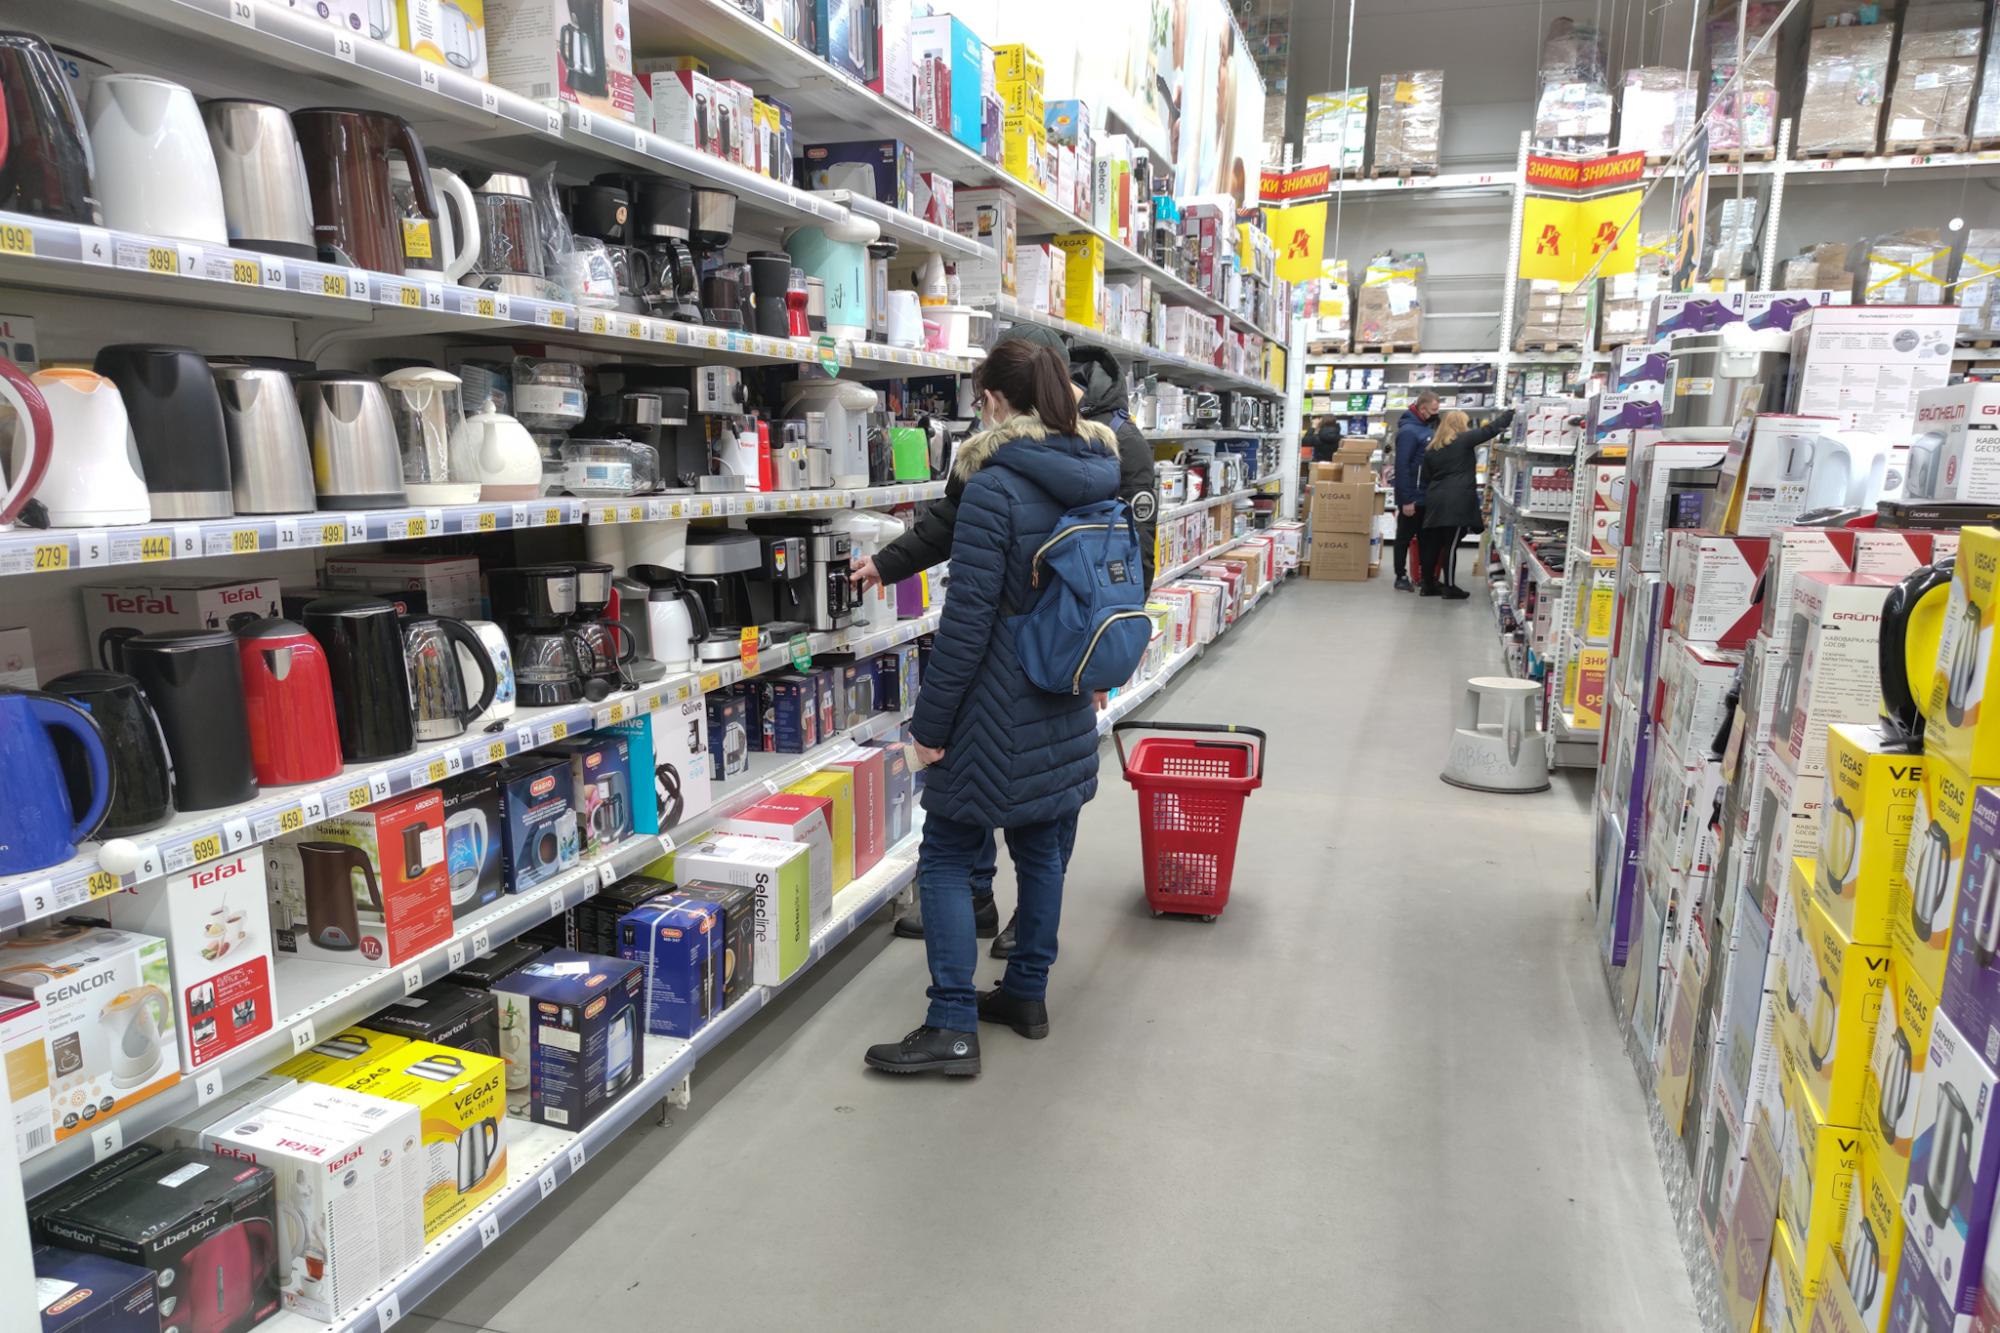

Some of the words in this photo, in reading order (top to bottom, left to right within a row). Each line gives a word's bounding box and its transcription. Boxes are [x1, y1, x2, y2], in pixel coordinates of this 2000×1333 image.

[236, 3, 250, 18] 10
[338, 40, 351, 54] 13
[424, 71, 434, 84] 16
[485, 94, 494, 106] 19
[549, 117, 559, 130] 22
[1528, 162, 1580, 181] ЗНИЖКИ
[1581, 157, 1642, 182] ЗНИЖКИ
[1281, 172, 1328, 193] ЗНИЖКИ
[92, 243, 102, 258] 4
[1056, 239, 1088, 247] VEGAS
[150, 248, 170, 270] 399
[188, 256, 196, 270] 7
[233, 264, 253, 282] 839
[267, 269, 282, 282] 10
[324, 276, 341, 294] 649
[354, 282, 366, 294] 13
[402, 288, 416, 306] 779
[430, 294, 440, 305] 16
[498, 302, 507, 313] 19
[515, 513, 524, 523] 20
[572, 510, 580, 519] 23
[352, 525, 363, 537] 14
[430, 520, 440, 530] 17
[234, 532, 255, 551] 1099
[282, 530, 294, 543] 11
[322, 526, 339, 543] 499
[143, 538, 165, 556] 444
[184, 538, 193, 551] 8
[36, 546, 62, 568] 279
[90, 546, 99, 559] 5
[218, 586, 263, 605] Tefal
[101, 593, 179, 615] Tefal
[520, 734, 530, 746] 21
[450, 758, 460, 769] 18
[1840, 752, 1863, 776] VEGAS
[375, 782, 386, 794] 15
[1939, 776, 1965, 806] VEGAS
[348, 787, 366, 807] 559
[307, 804, 320, 817] 12
[281, 810, 298, 830] 459
[235, 830, 242, 842] 9
[316, 826, 351, 837] Чайник
[193, 840, 215, 861] 699
[144, 860, 152, 873] 6
[187, 858, 247, 890] Tefal
[89, 872, 112, 896] 349
[34, 896, 45, 911] 3
[756, 873, 770, 943] Selecline
[474, 936, 487, 950] 20
[452, 952, 462, 964] 17
[46, 970, 115, 1007] SENCOR
[406, 974, 419, 988] 12
[1904, 982, 1928, 1021] VEGAS
[298, 1032, 310, 1045] 11
[346, 1067, 392, 1091] EGAS
[206, 1084, 214, 1095] 8
[454, 1076, 500, 1111] VEGAS
[104, 1136, 113, 1151] 5
[276, 1138, 329, 1157] Tefal
[212, 1143, 257, 1165] Tefal
[327, 1146, 365, 1174] Tefal
[573, 1152, 582, 1164] 18
[544, 1180, 553, 1192] 15
[1872, 1176, 1893, 1224] VEGAS
[47, 1222, 96, 1245] Liberton
[153, 1216, 216, 1252] Liberton
[484, 1226, 496, 1240] 14
[386, 1308, 393, 1321] 9
